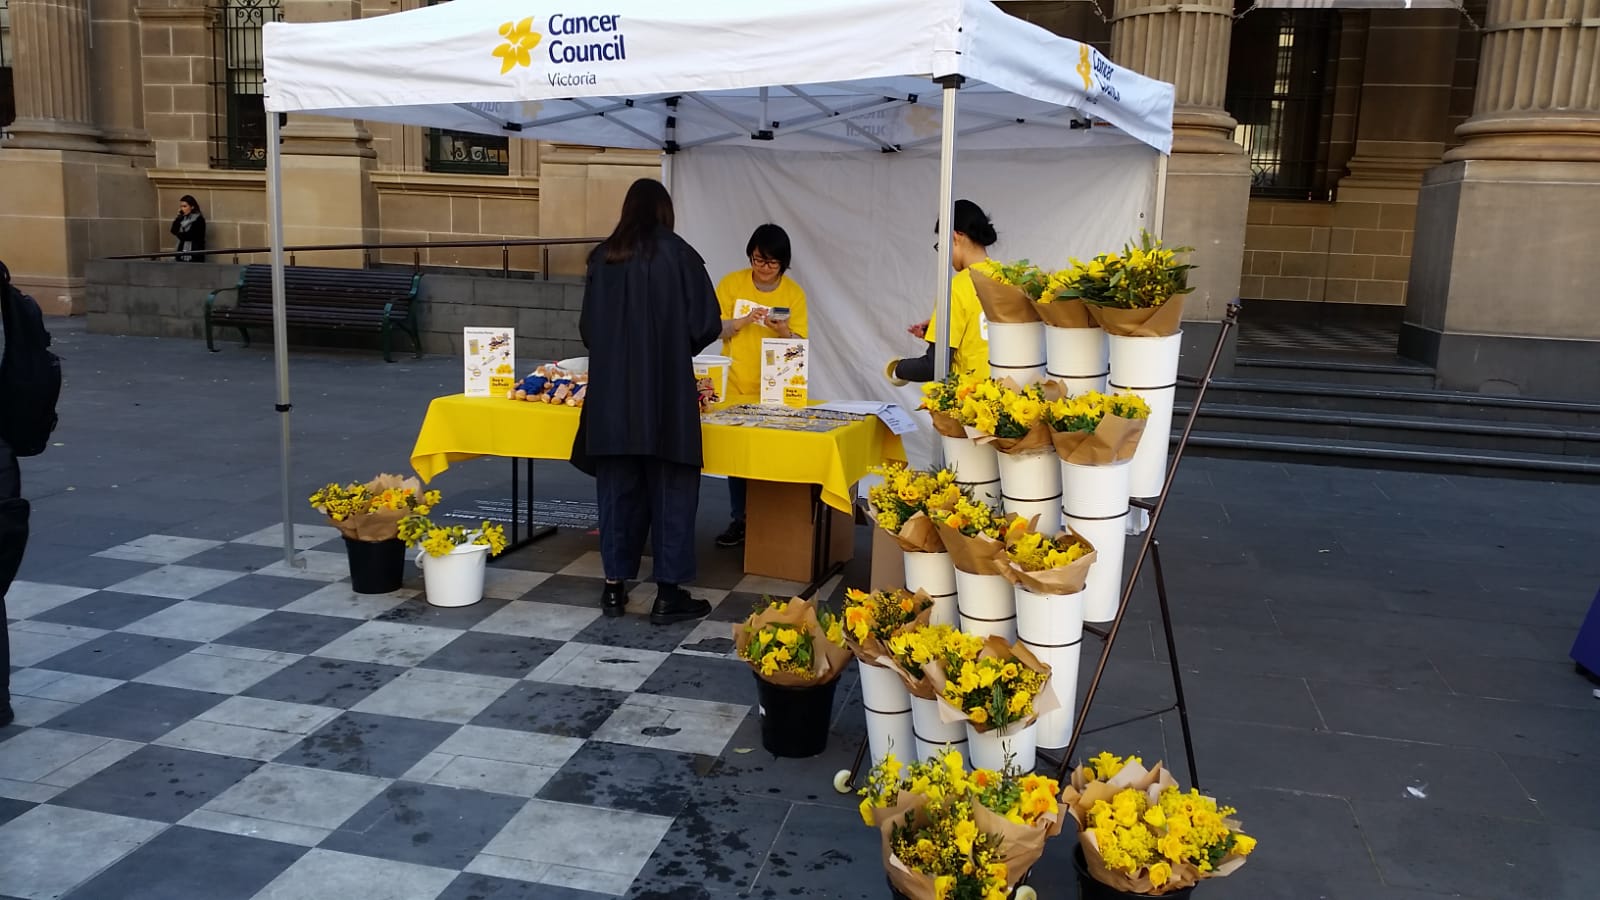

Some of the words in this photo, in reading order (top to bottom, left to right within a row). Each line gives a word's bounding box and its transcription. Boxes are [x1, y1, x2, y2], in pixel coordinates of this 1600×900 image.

[548, 13, 621, 36] Cancer
[548, 34, 626, 64] Council
[1092, 49, 1115, 81] Cancer
[547, 71, 597, 87] Victoria
